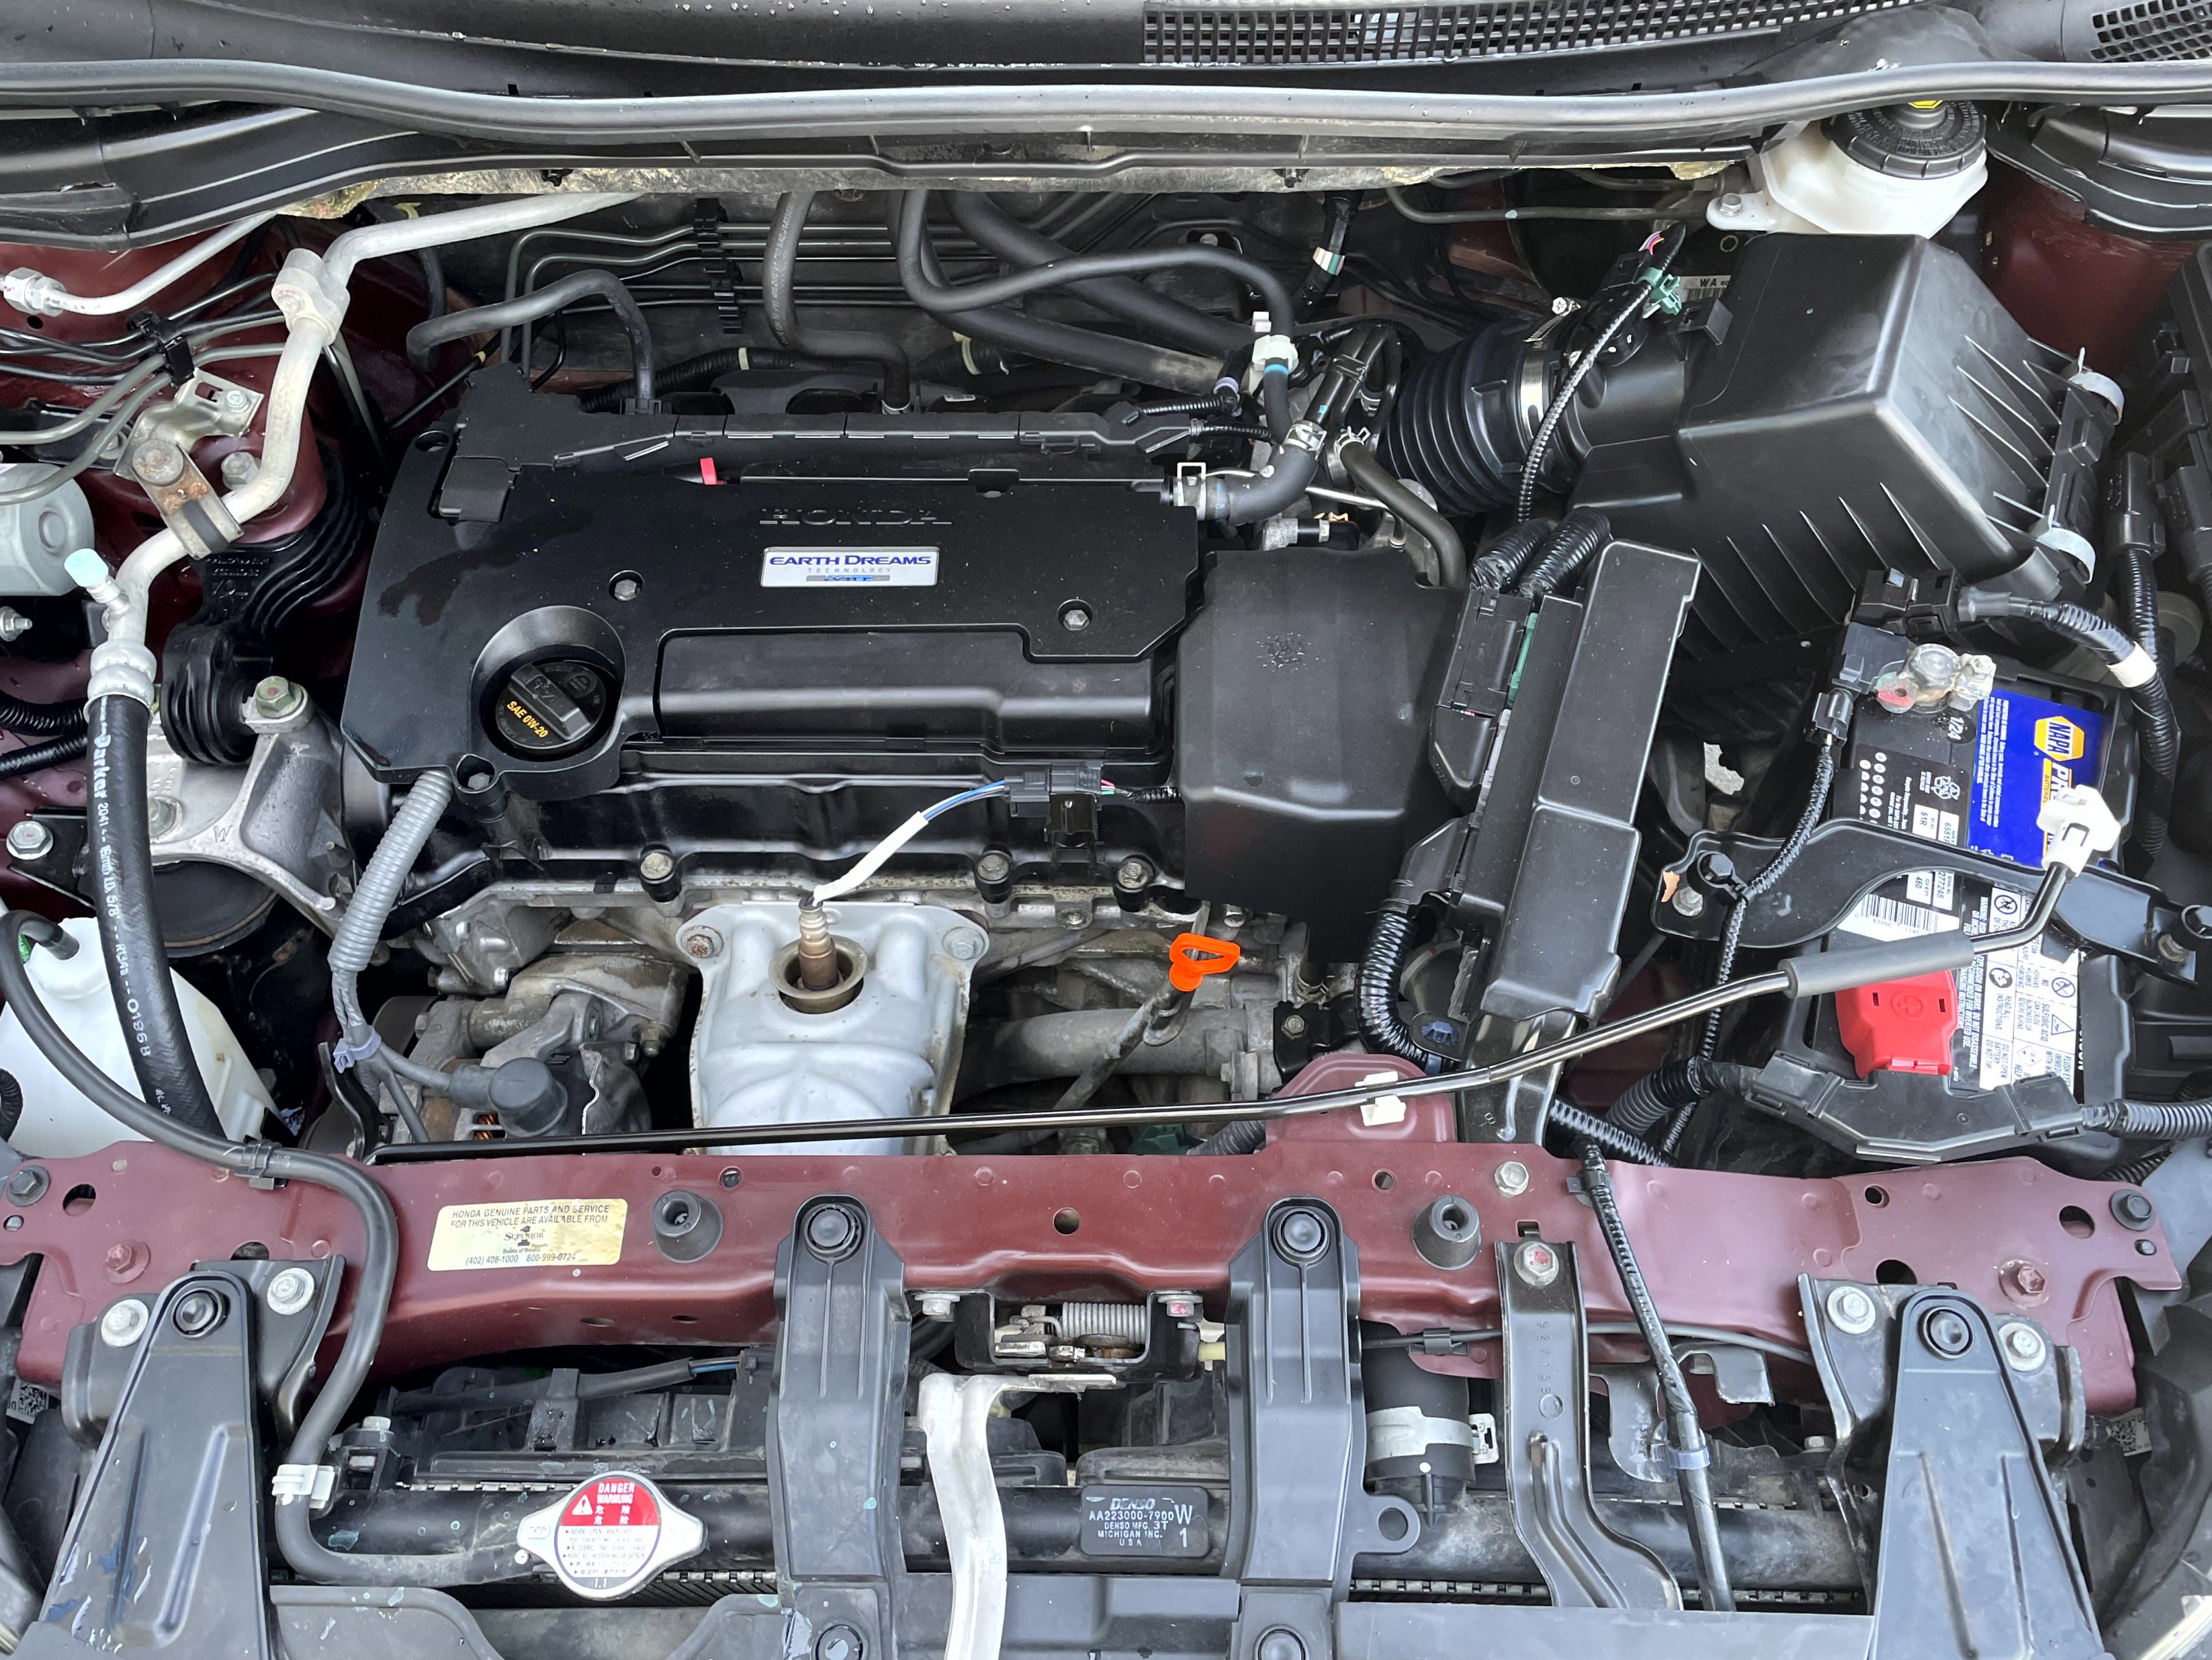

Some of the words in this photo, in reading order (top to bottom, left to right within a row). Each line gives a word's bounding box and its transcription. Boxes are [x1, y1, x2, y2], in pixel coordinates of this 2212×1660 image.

[1700, 278, 1717, 287] WA
[759, 508, 952, 525] HONDA
[770, 556, 840, 565] EARTH
[845, 555, 932, 565] DREAMS
[507, 700, 527, 718] SAE
[522, 715, 549, 738] 0W-20
[1947, 716, 1965, 740] 1/24
[2047, 721, 2071, 755] NAPA
[93, 734, 111, 799] Parker
[97, 802, 109, 827] 2041
[1975, 955, 1984, 983] EXPLOSION
[1974, 984, 1983, 992] OR
[1965, 999, 1974, 1009] FOR
[1972, 1012, 1980, 1020] DO
[2025, 999, 2034, 1025] BLINDNESS
[2043, 1003, 2051, 1029] SULFURIC
[1964, 1010, 1973, 1035] INVERTED
[1971, 1020, 1980, 1032] NOT
[2016, 1014, 2025, 1030] BURNS
[2040, 1029, 2049, 1042] ACID
[1986, 1039, 1994, 1048] DO
[2002, 1044, 2010, 1052] DO
[1993, 1041, 2002, 1064] BATTERY
[2045, 1050, 2053, 1065] WITH
[2063, 1055, 2072, 1072] FLUSH
[2000, 1063, 2009, 1079] OPEN
[452, 1209, 480, 1218] HONDA
[483, 1208, 520, 1217] GENUINE
[522, 1206, 549, 1215] PARTS
[551, 1206, 570, 1214] AND
[573, 1205, 609, 1214] SERVICE
[451, 1220, 466, 1228] FOR
[468, 1218, 486, 1227] THIS
[486, 1218, 519, 1227] VEHICLE
[520, 1216, 537, 1225] ARE
[538, 1215, 582, 1224] AVAILABLE
[584, 1215, 608, 1224] FROM
[504, 1232, 544, 1242] SUPERIOR
[465, 1256, 484, 1266] (402)
[486, 1254, 519, 1264] 408-1000
[526, 1253, 576, 1263] 800-999-0724
[597, 1482, 636, 1494] DANGER
[1109, 1497, 1156, 1511] DENSO
[1088, 1511, 1174, 1521] AA223000-7900
[1174, 1504, 1193, 1525] W
[1104, 1521, 1130, 1530] DENSO
[1132, 1522, 1151, 1530] MFG.
[1153, 1521, 1169, 1530] 3T
[1179, 1527, 1187, 1548] 1
[594, 1578, 607, 1588] 1.1
